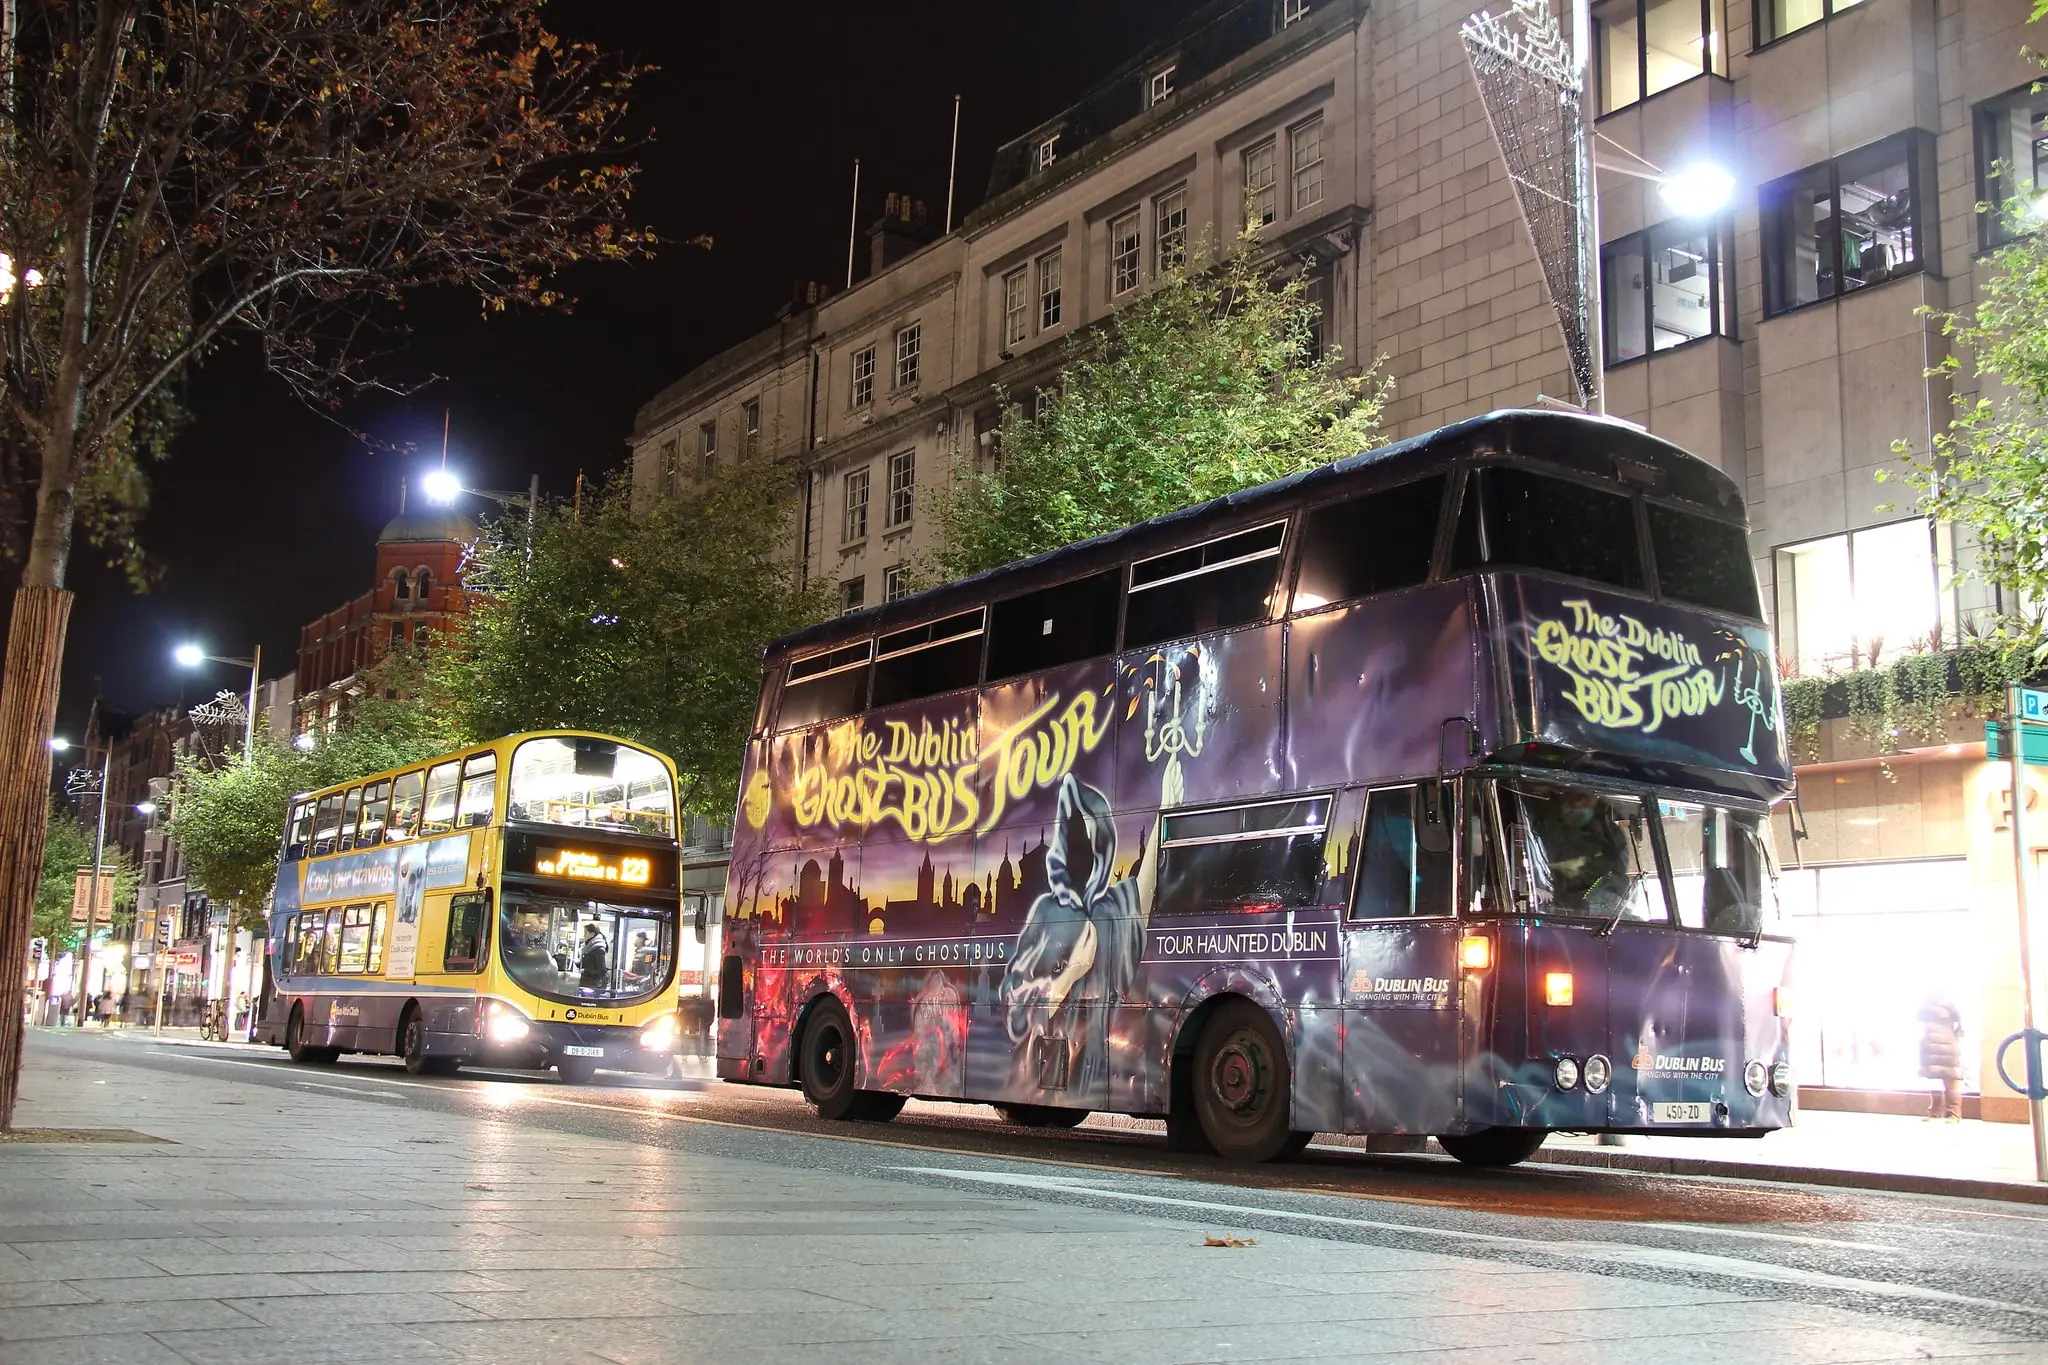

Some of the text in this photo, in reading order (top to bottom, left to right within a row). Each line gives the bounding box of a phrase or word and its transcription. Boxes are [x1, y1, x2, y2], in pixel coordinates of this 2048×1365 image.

[1561, 600, 1703, 666] The Dublin
[2028, 698, 2036, 712] P
[829, 720, 977, 770] The Dublin
[309, 860, 394, 895] Cool your cravings
[621, 857, 650, 884] 123
[1156, 930, 1327, 955] TOUR HAUNTED DUBLIN
[761, 950, 786, 964] THE
[793, 948, 850, 964] WORLD'S
[862, 946, 906, 963] ONLY
[1374, 977, 1450, 993] DUBLIN BUS
[1355, 993, 1391, 1001] CHANGING
[1393, 993, 1411, 1001] WITH
[1412, 993, 1425, 1001] THE
[1655, 1055, 1725, 1072] DUBLIN BUS
[1637, 1071, 1671, 1079] CHANGING
[1689, 1072, 1702, 1080] THE
